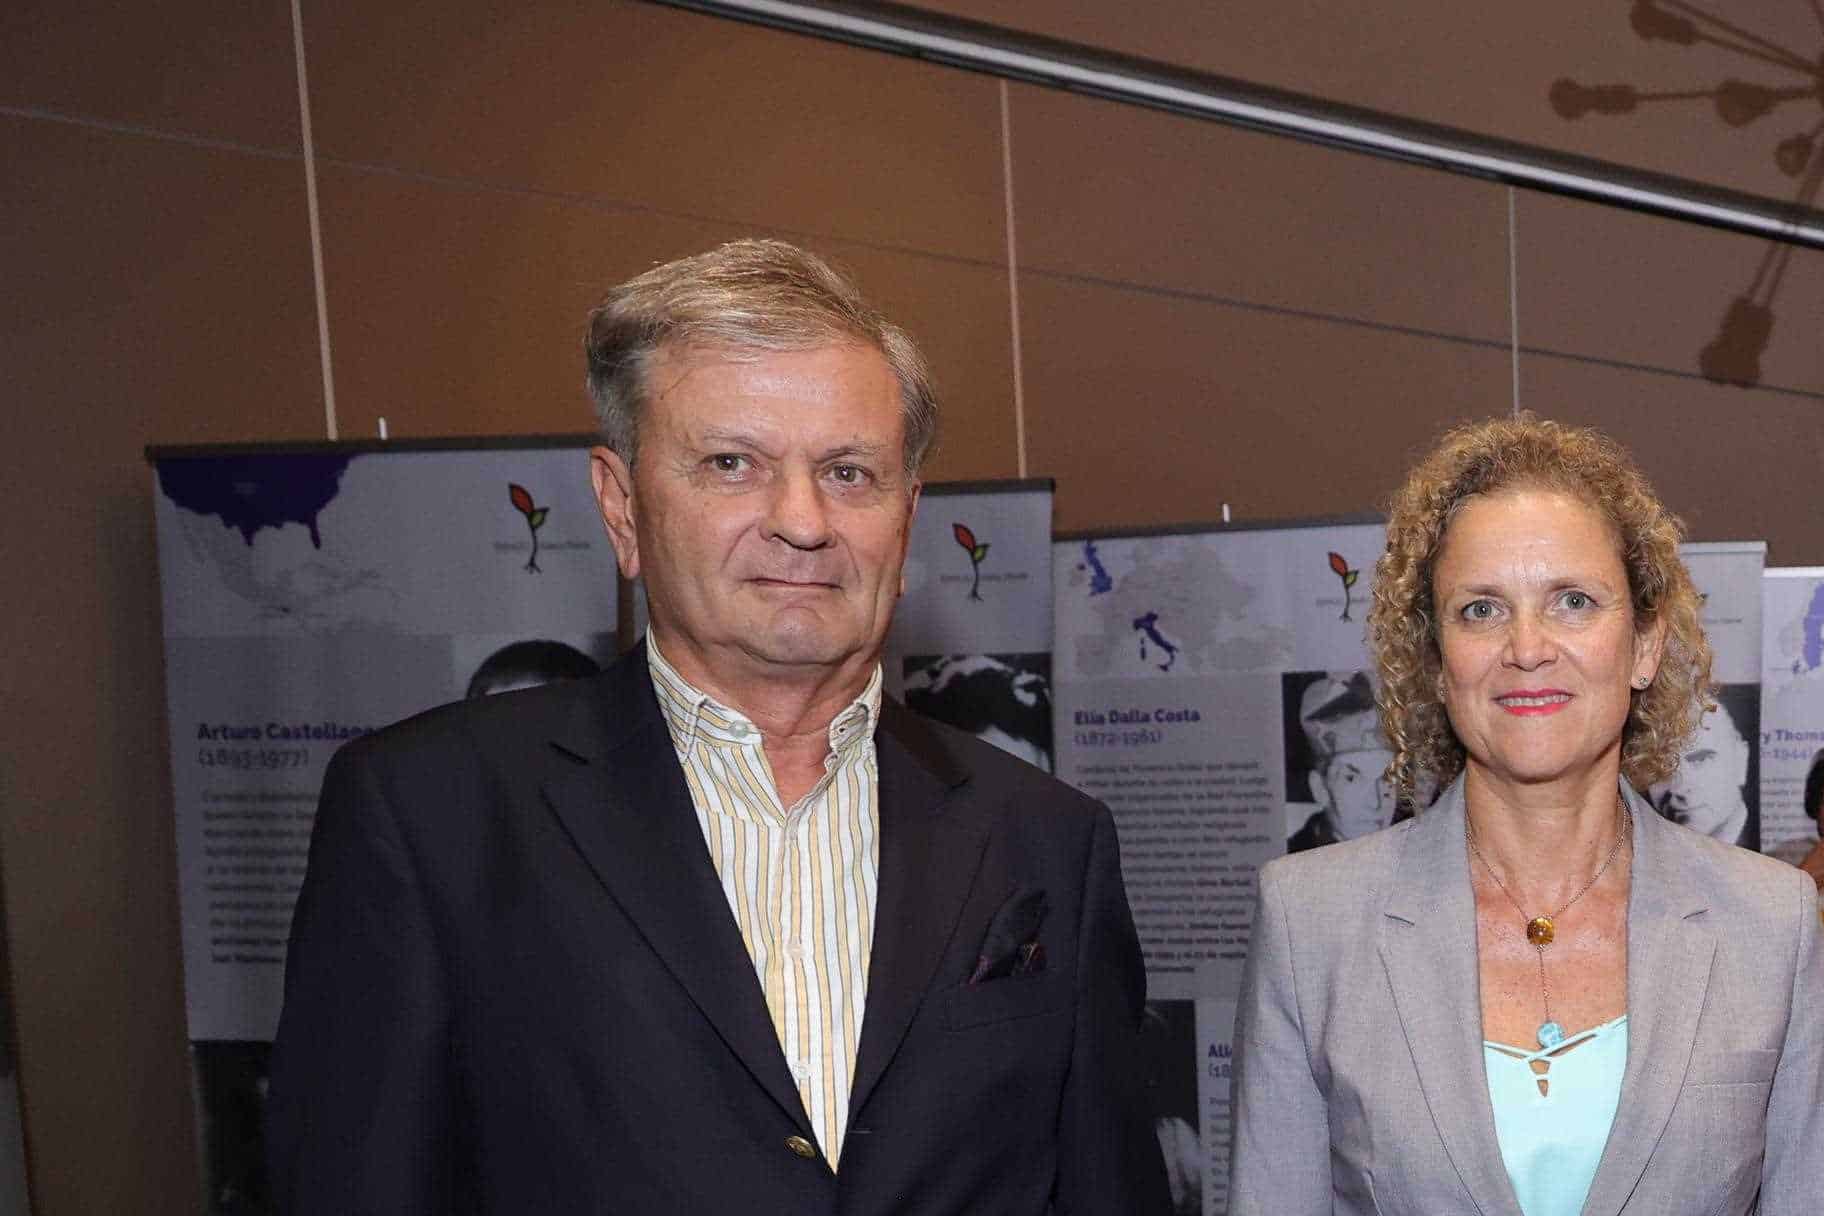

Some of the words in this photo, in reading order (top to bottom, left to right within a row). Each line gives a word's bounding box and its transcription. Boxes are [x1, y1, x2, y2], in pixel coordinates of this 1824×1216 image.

[1074, 710, 1104, 725] Elia
[1108, 709, 1150, 724] Dalla
[1153, 708, 1201, 723] Costa
[197, 722, 262, 740] Arturo
